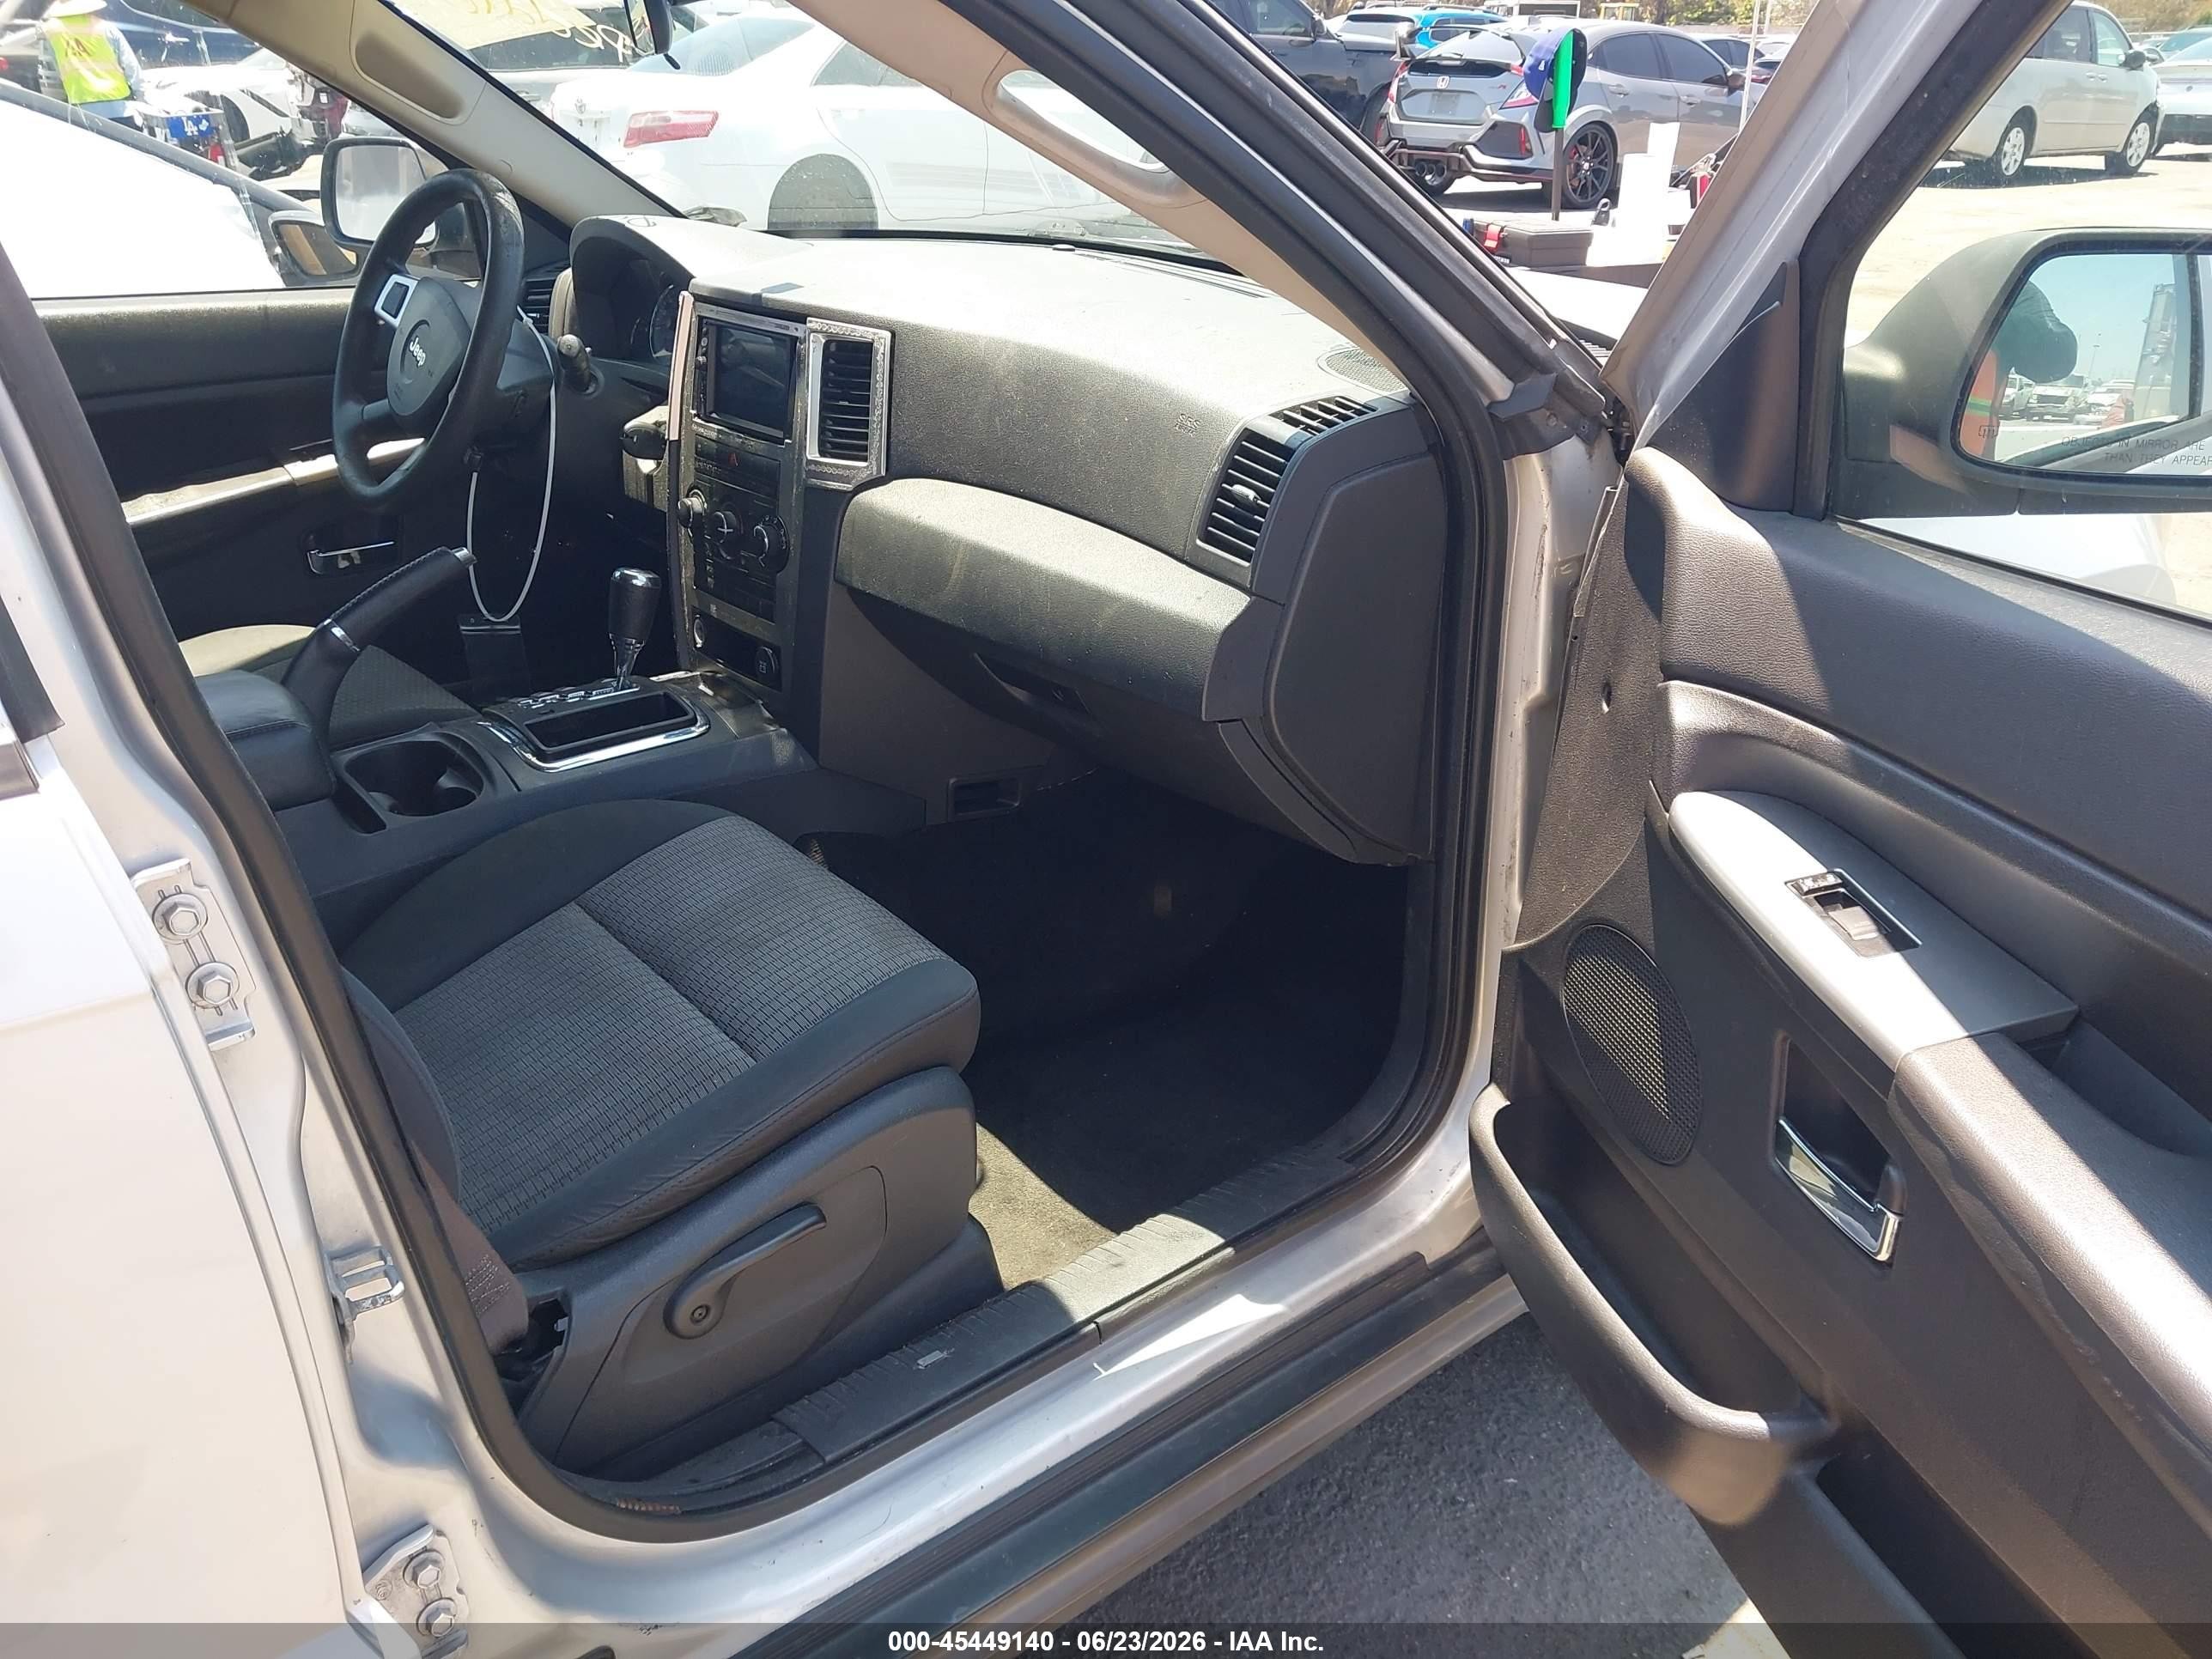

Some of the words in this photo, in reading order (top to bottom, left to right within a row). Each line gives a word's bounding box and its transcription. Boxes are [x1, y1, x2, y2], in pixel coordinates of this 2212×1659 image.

[409, 337, 426, 368] Jeep
[2118, 439, 2130, 447] IN
[2136, 439, 2179, 451] MIRROR
[2185, 440, 2206, 451] ARE
[2104, 452, 2133, 464] THAN
[2141, 453, 2166, 465] THEY
